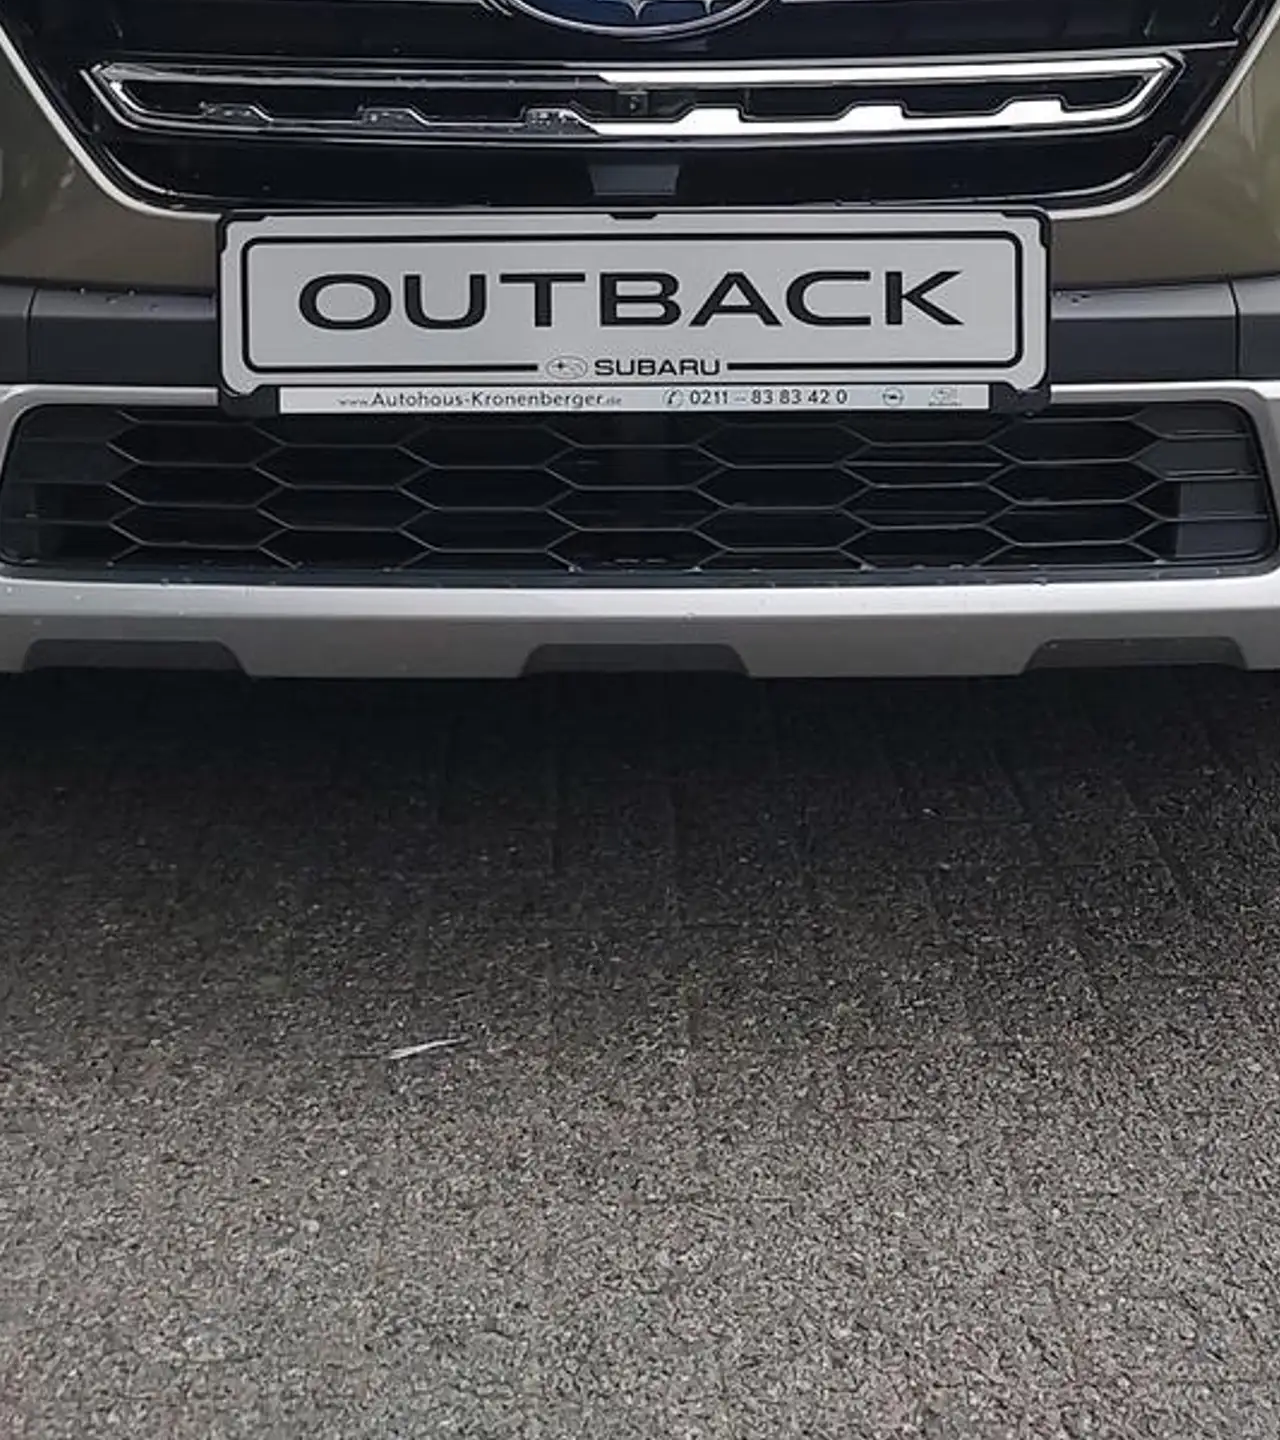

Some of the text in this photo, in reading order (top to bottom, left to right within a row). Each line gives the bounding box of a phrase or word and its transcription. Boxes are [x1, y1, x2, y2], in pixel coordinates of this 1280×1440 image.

[298, 270, 965, 330] OUTBACK
[594, 359, 721, 377] SUBARU
[689, 389, 729, 405] 0211
[750, 389, 773, 405] 83
[779, 389, 802, 405] 83
[807, 389, 830, 405] 42
[835, 388, 849, 405] 0
